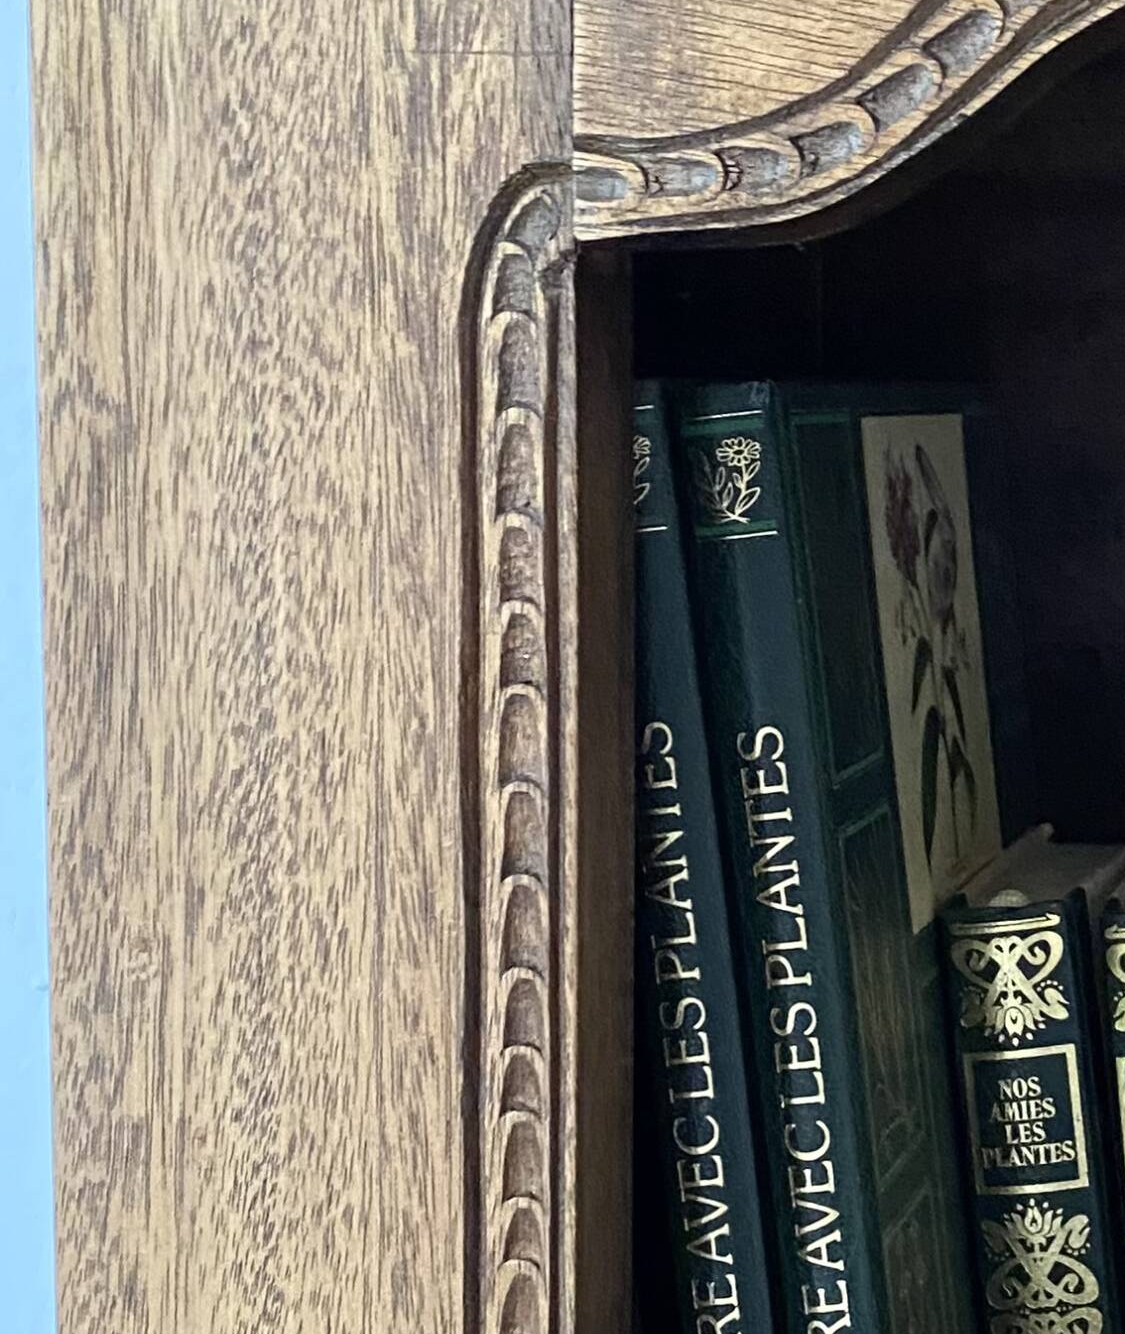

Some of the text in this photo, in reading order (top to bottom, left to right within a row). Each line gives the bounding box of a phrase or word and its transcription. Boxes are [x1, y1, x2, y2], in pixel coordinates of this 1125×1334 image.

[641, 721, 701, 985] PLANTES
[736, 725, 812, 989] PLANTES
[659, 997, 714, 1104] LES
[770, 1002, 825, 1109] LES
[999, 1076, 1042, 1099] NOS
[981, 1140, 1076, 1169] PLANTES
[991, 1097, 1056, 1122] AMIES
[1005, 1121, 1046, 1145] LES
[673, 1115, 734, 1265] AVEC
[784, 1120, 844, 1271] AVEC
